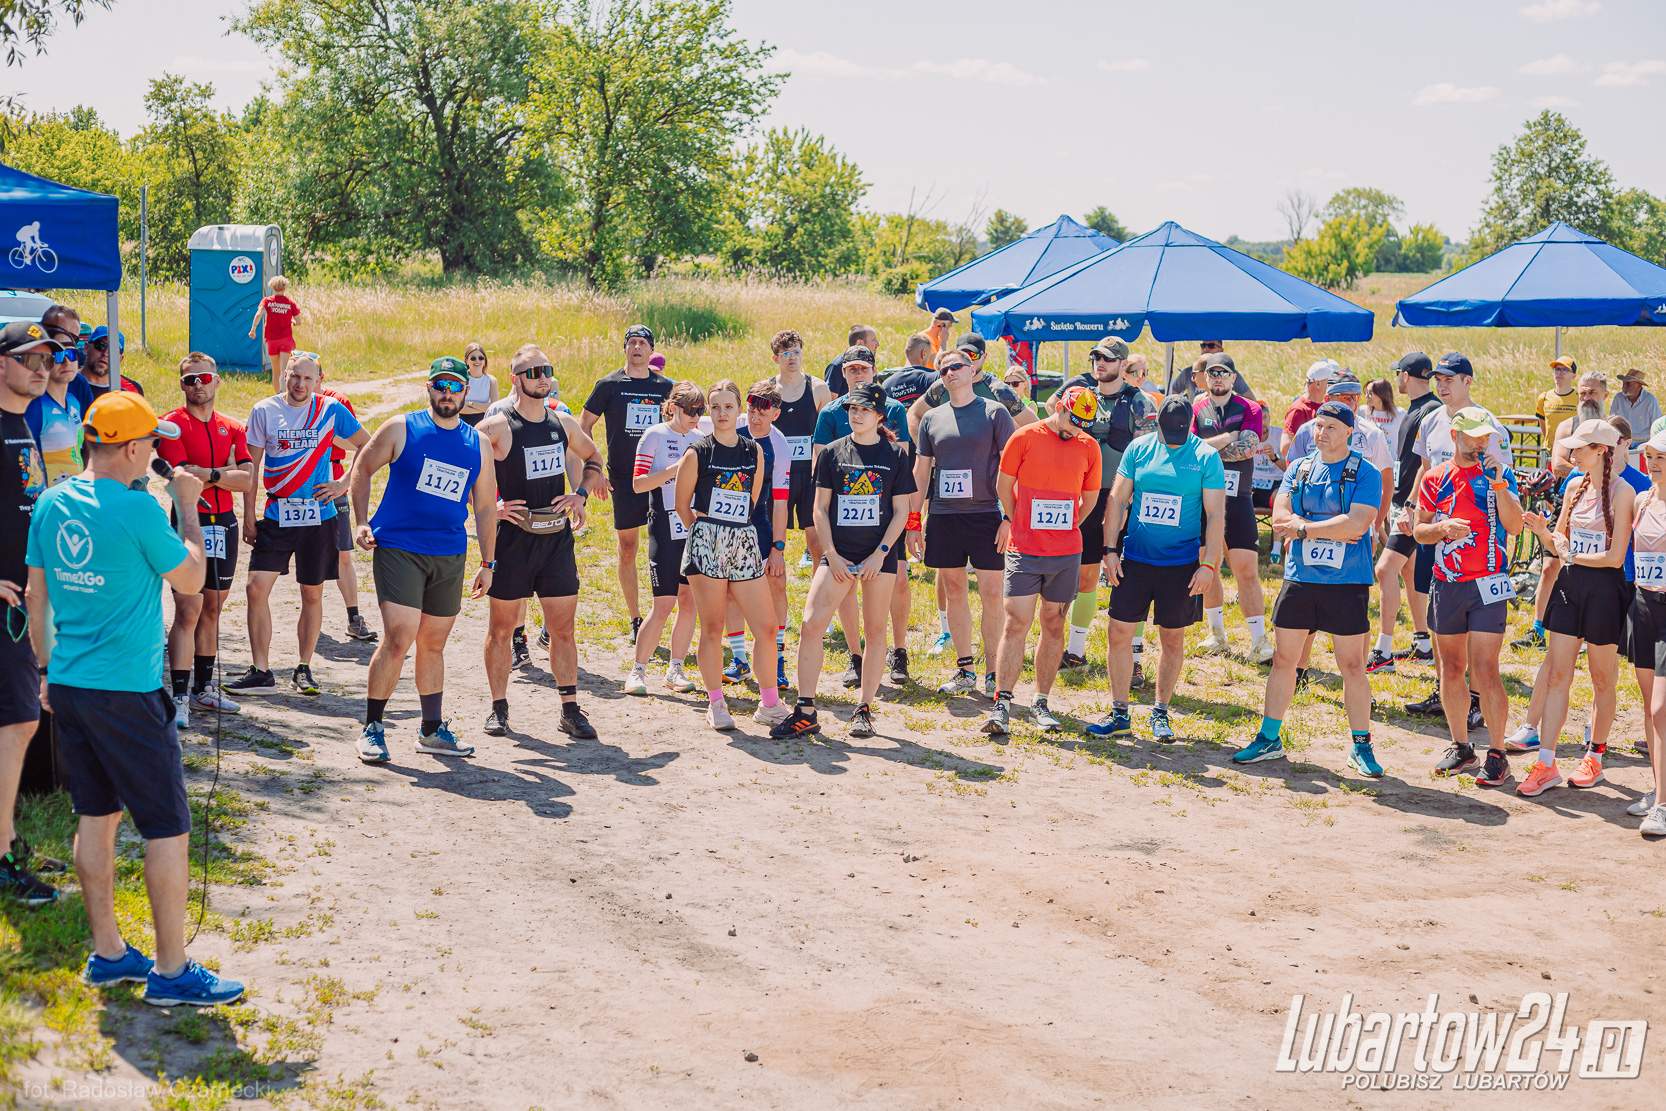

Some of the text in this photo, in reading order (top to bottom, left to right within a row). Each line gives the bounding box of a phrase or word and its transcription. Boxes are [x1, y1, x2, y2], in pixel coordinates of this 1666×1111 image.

[634, 413, 653, 425] 1/1
[278, 429, 319, 439] NIEMCE
[290, 439, 318, 450] TEAM
[792, 445, 805, 456] /2
[532, 456, 562, 473] 11/1
[425, 473, 460, 494] 11/2
[944, 481, 964, 493] 2/1
[284, 508, 316, 521] 13/2
[714, 501, 746, 517] 22/2
[842, 507, 875, 520] 22/1
[1144, 505, 1176, 520] 12/2
[1037, 511, 1069, 525] 12/1
[1310, 546, 1334, 561] 6/1
[53, 567, 105, 586] Time2Go
[1489, 580, 1512, 596] 6/2
